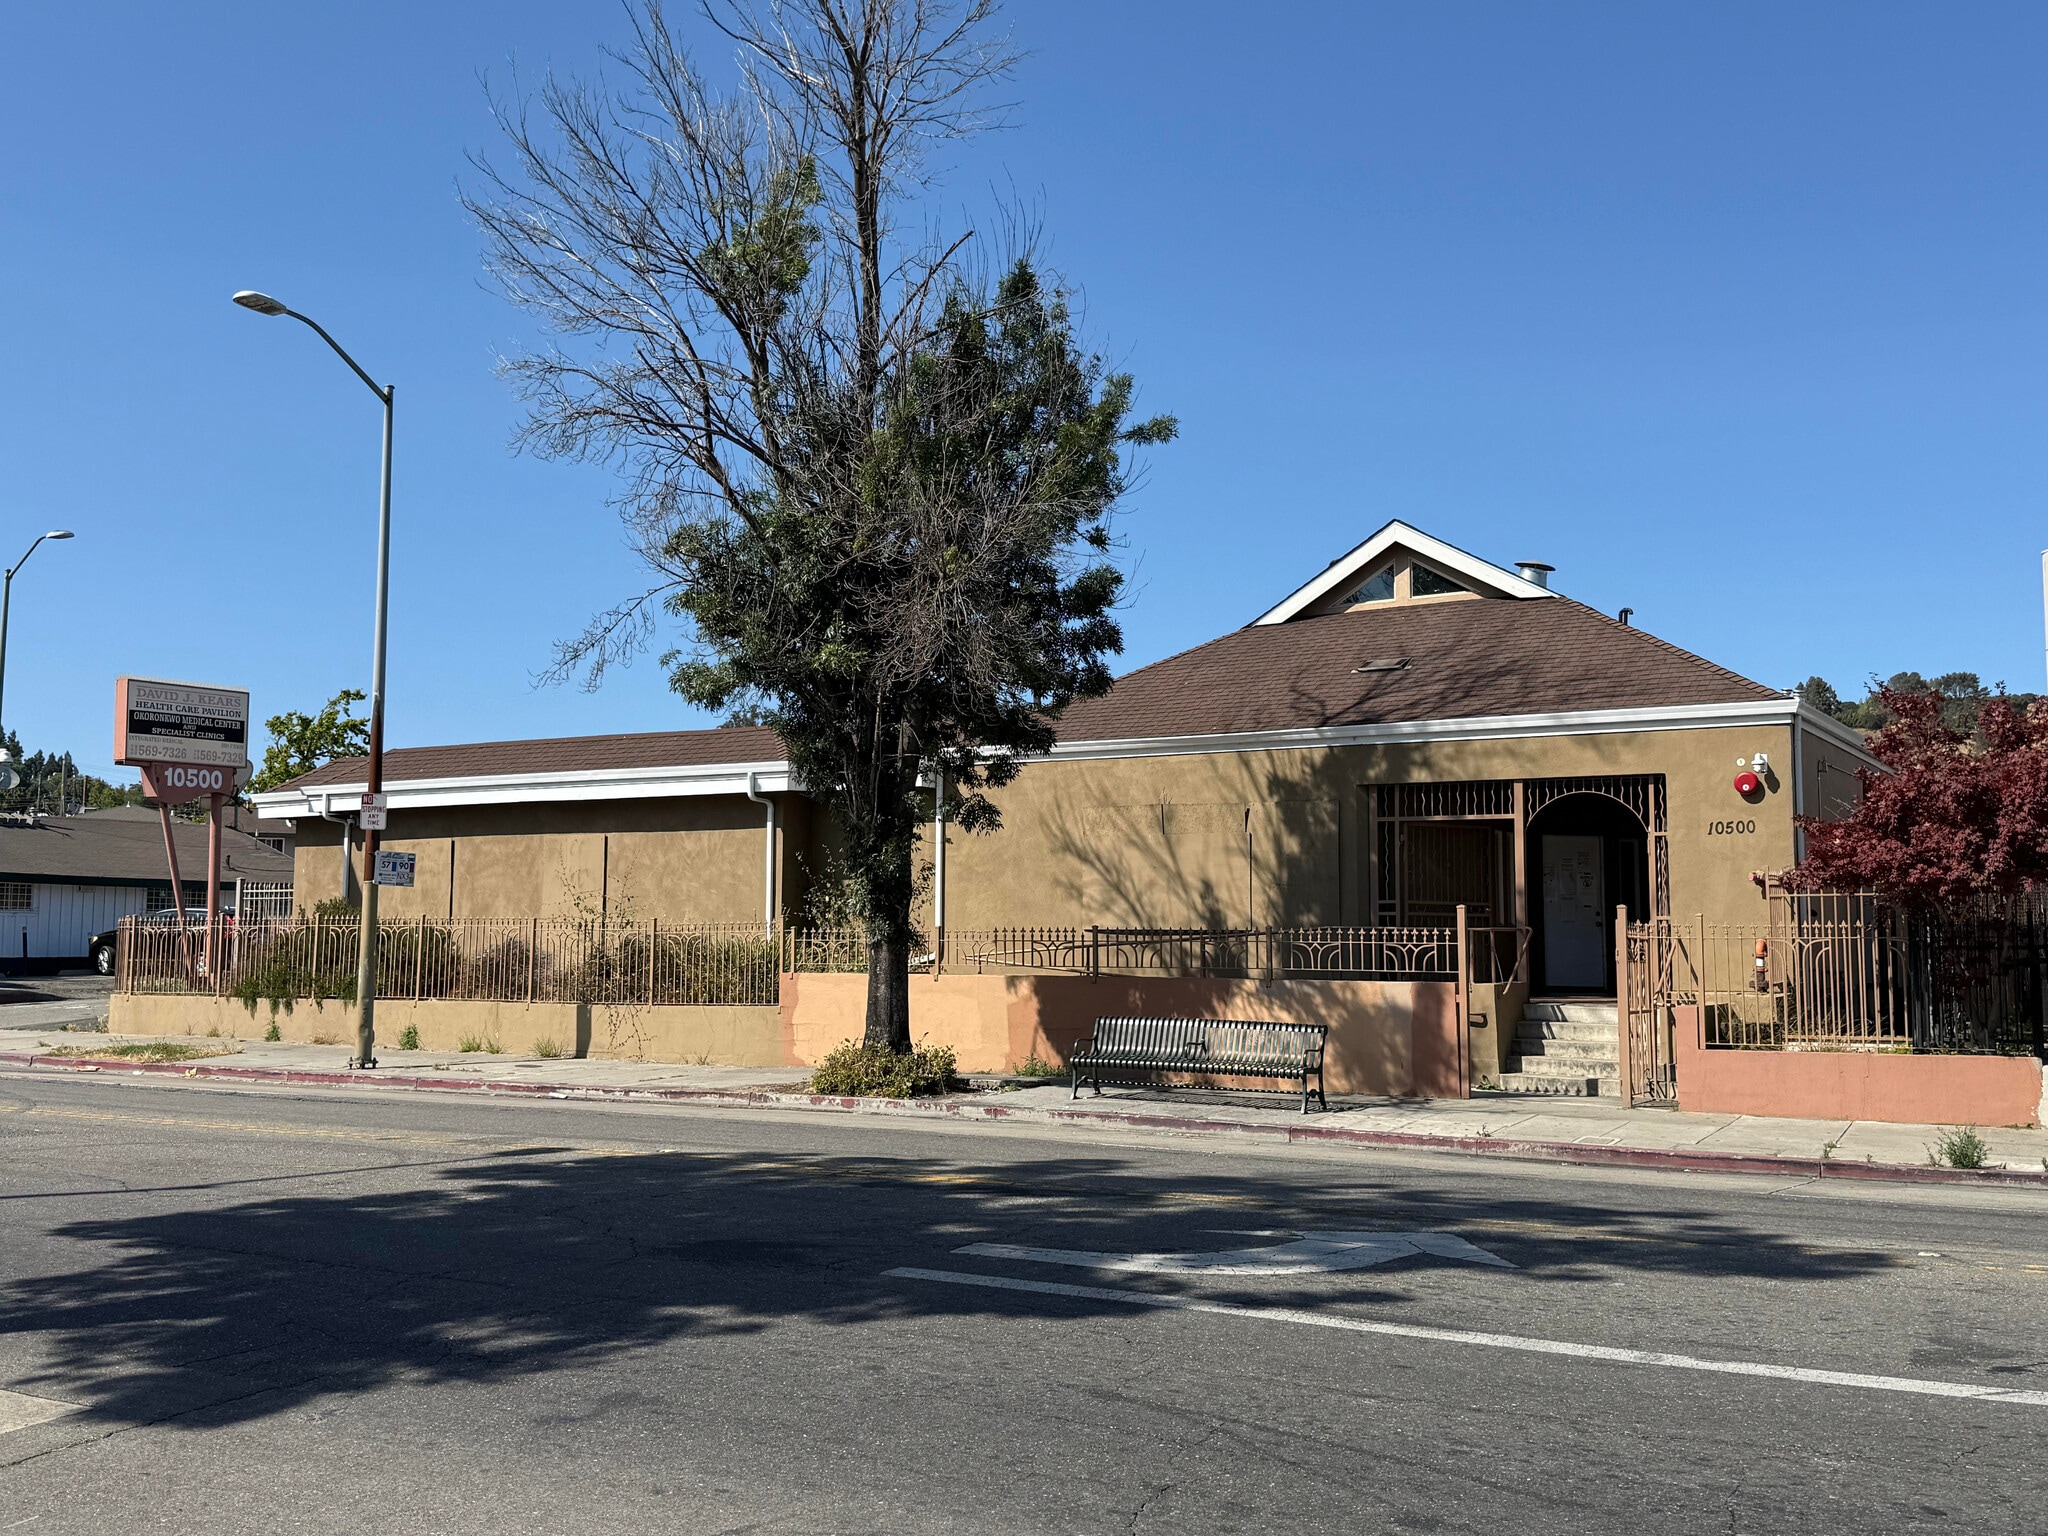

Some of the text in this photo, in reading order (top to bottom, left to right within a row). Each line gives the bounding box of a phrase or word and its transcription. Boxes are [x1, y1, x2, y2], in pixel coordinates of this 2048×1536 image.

[137, 688, 241, 708] DAVID J. KEARS
[135, 701, 242, 718] HEALTH CARE PAVILION
[133, 711, 241, 730] OKORONKWO MEDICAL CENTER
[151, 727, 225, 741] SPECIALIST CLINICS
[138, 745, 187, 759] 569-7326
[200, 750, 244, 764] 569-7329
[164, 767, 223, 790] 10500
[363, 795, 373, 804] NO
[362, 805, 386, 813] STOPPING
[1707, 820, 1756, 836] 10500
[381, 861, 391, 869] 57
[399, 862, 409, 870] 90
